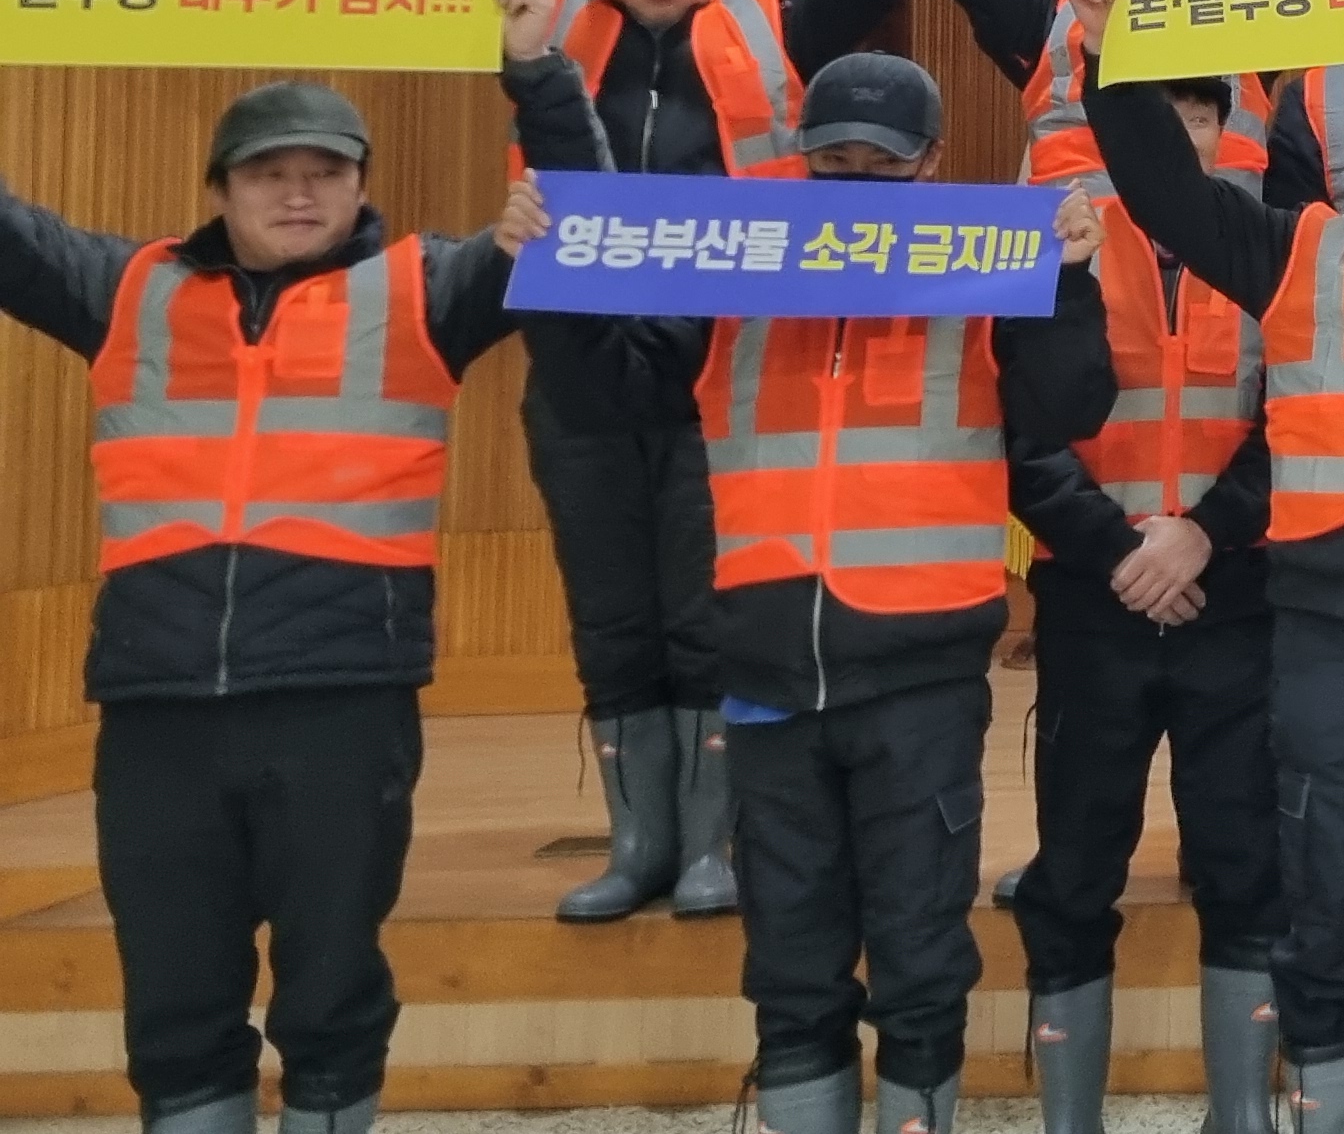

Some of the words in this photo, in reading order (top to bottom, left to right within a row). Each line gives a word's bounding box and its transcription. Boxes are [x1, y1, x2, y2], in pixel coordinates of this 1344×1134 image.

[557, 215, 789, 271] 영농부산물
[800, 222, 897, 273] 소각
[908, 225, 1041, 274] 금지!!!
